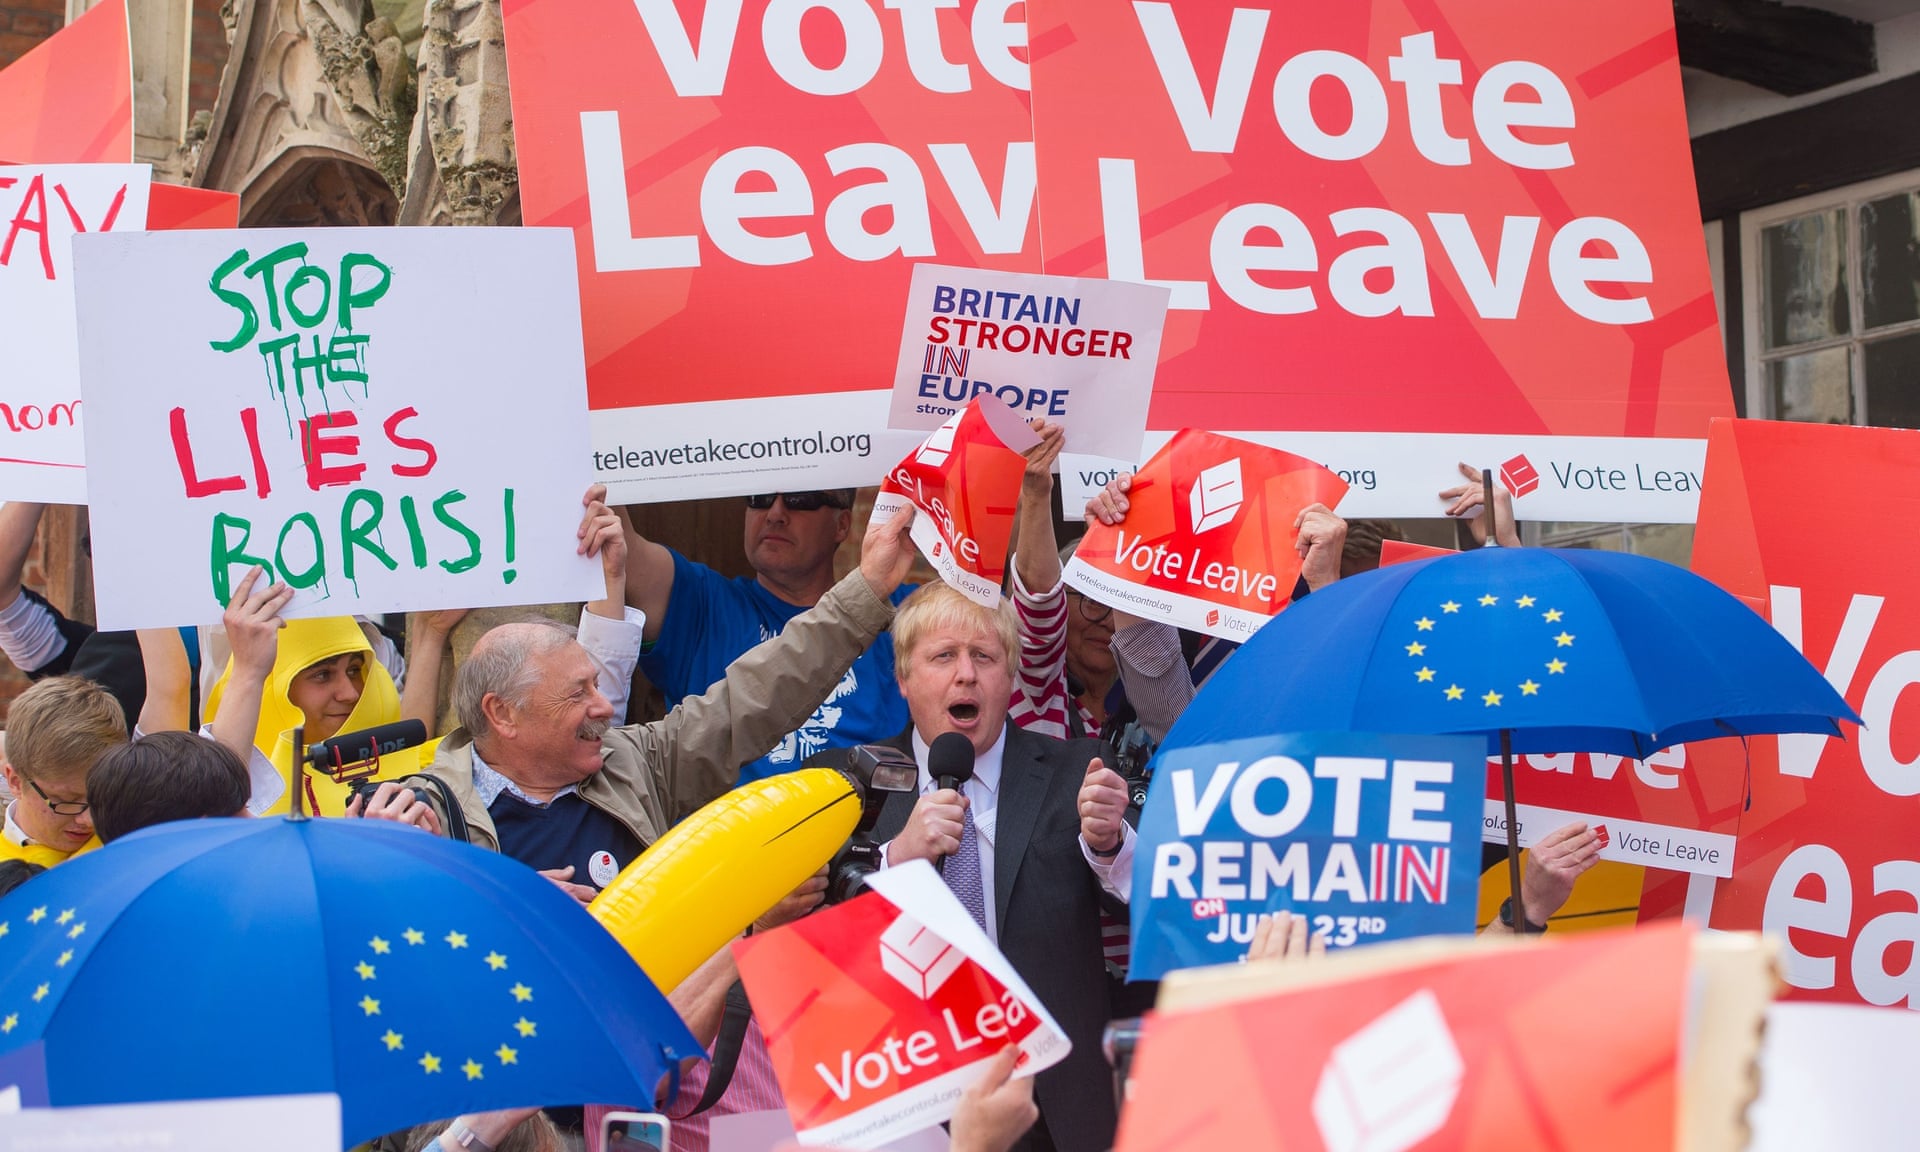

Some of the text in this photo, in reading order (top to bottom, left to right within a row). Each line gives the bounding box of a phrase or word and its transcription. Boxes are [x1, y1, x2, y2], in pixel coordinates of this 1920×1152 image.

[1130, 0, 1577, 170] Vote
[1098, 158, 1655, 325] Leave
[209, 242, 393, 351] STOP
[933, 285, 1080, 326] BRITAIN
[259, 333, 371, 398] THE
[923, 344, 971, 378] IN
[927, 316, 1133, 360] STRONGER
[169, 406, 438, 499] LIES
[593, 430, 871, 471] teleavetakecontrol.org
[1551, 461, 1626, 490] Vote
[210, 487, 517, 608] BORIS!
[917, 477, 980, 563] Leave
[956, 573, 991, 598] Leave
[1075, 570, 1173, 614] voteleavetakecontrol.org
[1114, 530, 1277, 602] Vote Leave
[1223, 614, 1247, 632] Vote
[1171, 755, 1454, 842] VOTE
[1151, 841, 1451, 904] REMAIN
[1618, 831, 1720, 865] Vote Leave
[1194, 899, 1225, 917] ON
[814, 1030, 940, 1102] Vote
